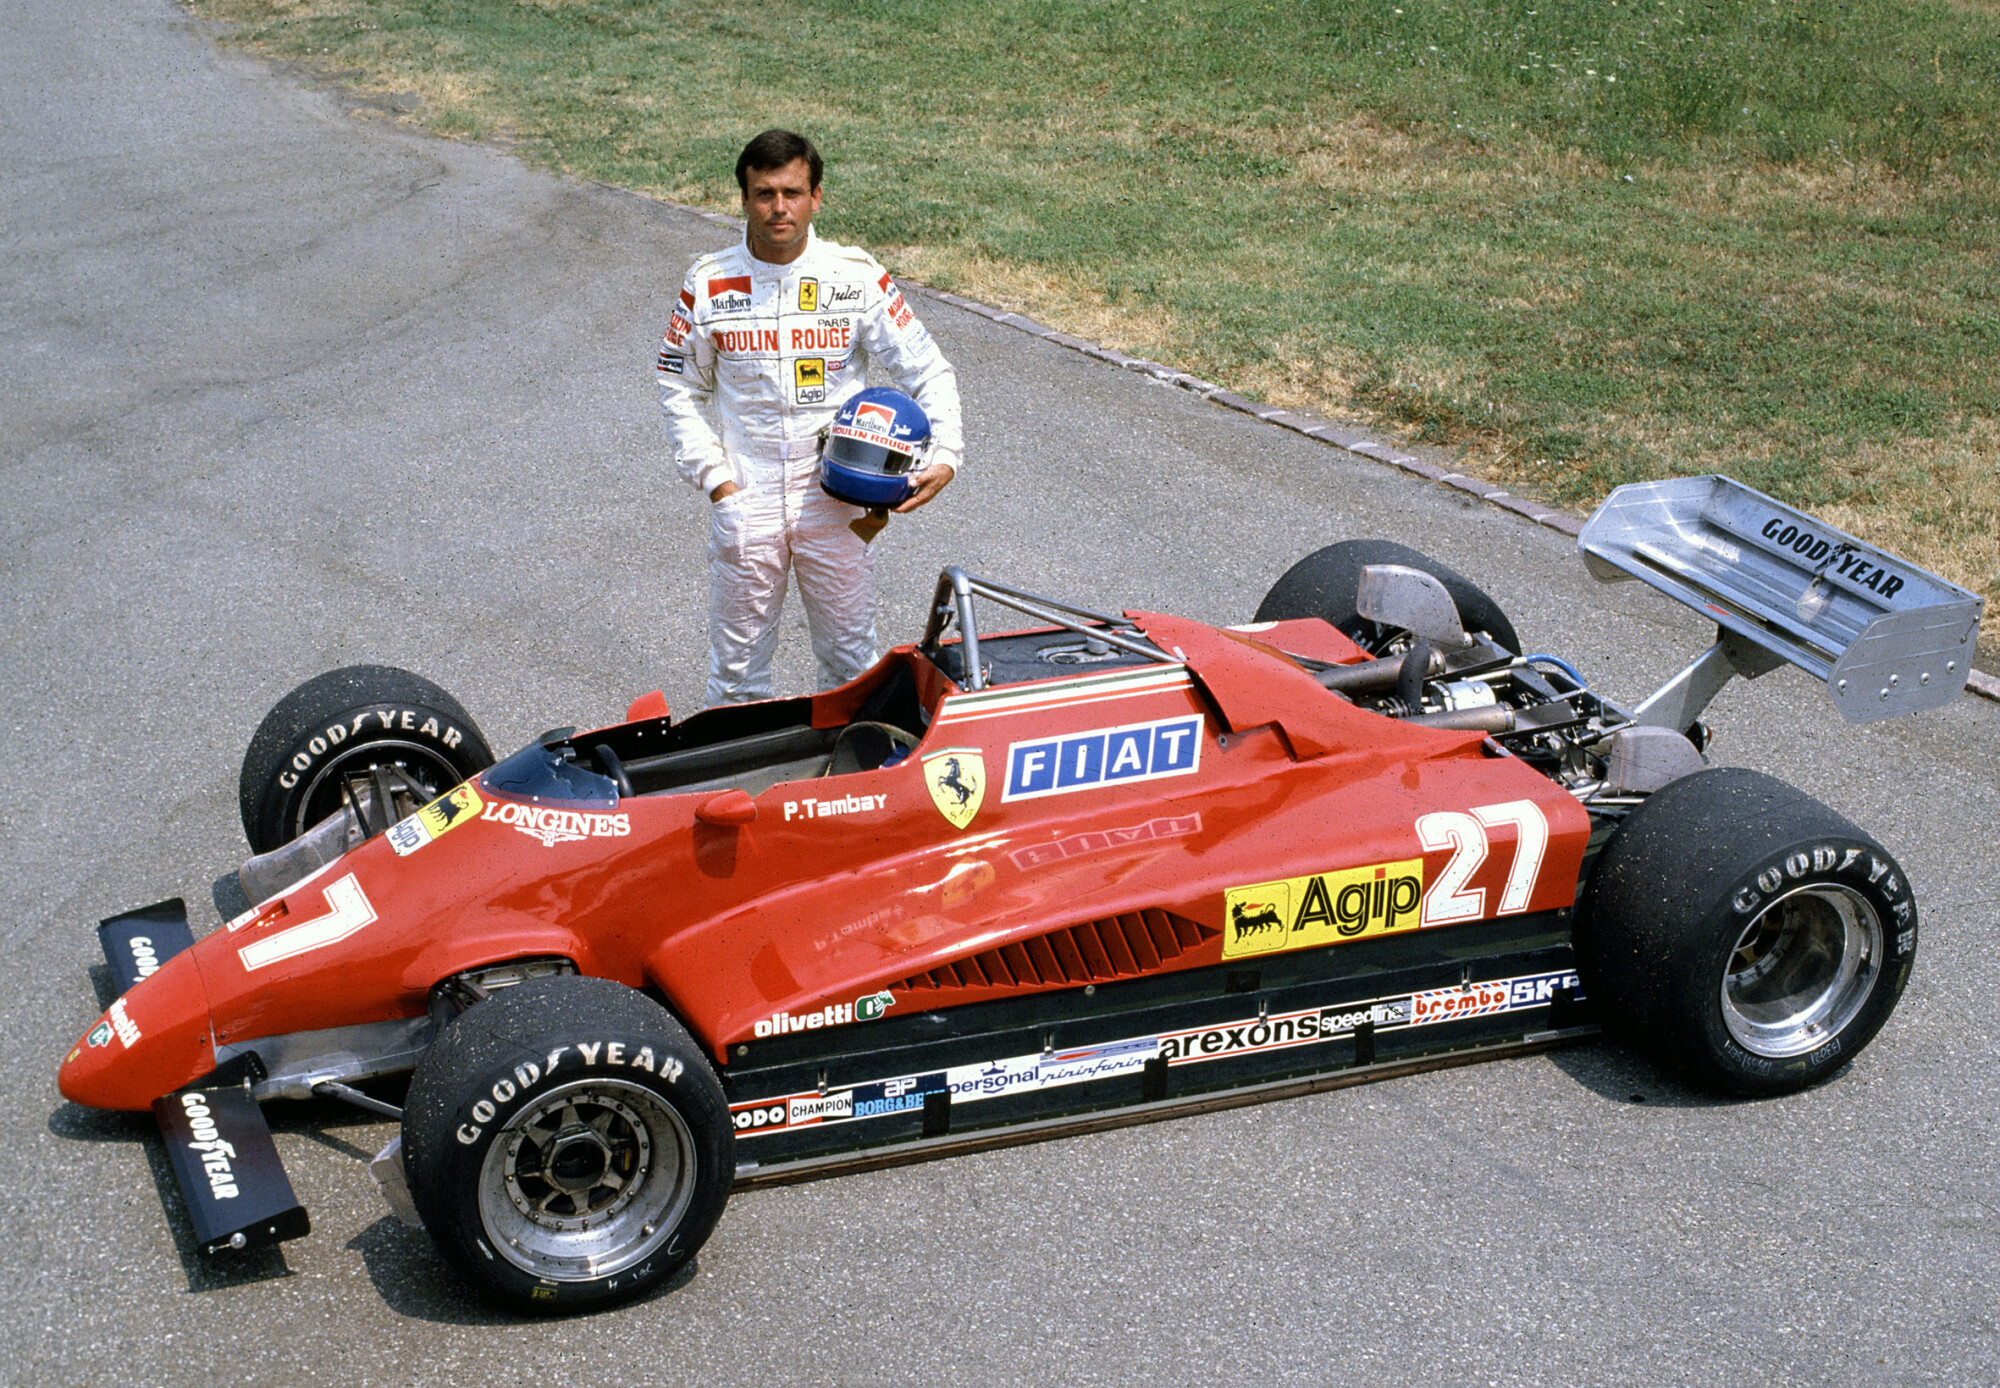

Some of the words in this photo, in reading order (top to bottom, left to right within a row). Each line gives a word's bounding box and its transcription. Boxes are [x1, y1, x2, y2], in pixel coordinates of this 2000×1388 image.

[711, 294, 752, 310] Marlboro
[822, 285, 862, 310] Jules
[818, 317, 850, 328] PARIS
[711, 329, 778, 352] MOULIN
[791, 327, 850, 350] ROUGE
[800, 387, 823, 401] Agip
[832, 425, 867, 439] MOULIN
[870, 434, 912, 454] ROUGE
[856, 416, 887, 433] Marlboro
[1761, 517, 1905, 601] GOODYEAR
[279, 709, 463, 790] GOODYEAR
[1020, 728, 1192, 788] FIAT
[390, 816, 421, 849] Agip
[481, 801, 631, 837] LONGINES
[1414, 799, 1549, 929] 27
[1291, 867, 1421, 937] Agip
[1733, 846, 1915, 956] GOODYEAR
[227, 872, 378, 972] 7
[129, 936, 161, 982] GOOD
[1415, 988, 1506, 1015] brembo
[754, 1000, 852, 1037] olivetti
[1320, 1003, 1404, 1034] speedline
[1157, 1013, 1320, 1060] arexons
[947, 1065, 1039, 1094] personal
[1039, 1058, 1155, 1085] pininfarin
[456, 1041, 685, 1145] GOODYEAR
[791, 1097, 851, 1118] CHAMPION
[854, 1088, 946, 1117] BORG&BE
[731, 1106, 786, 1129] ODO
[181, 1093, 240, 1200] GOODYEAR
